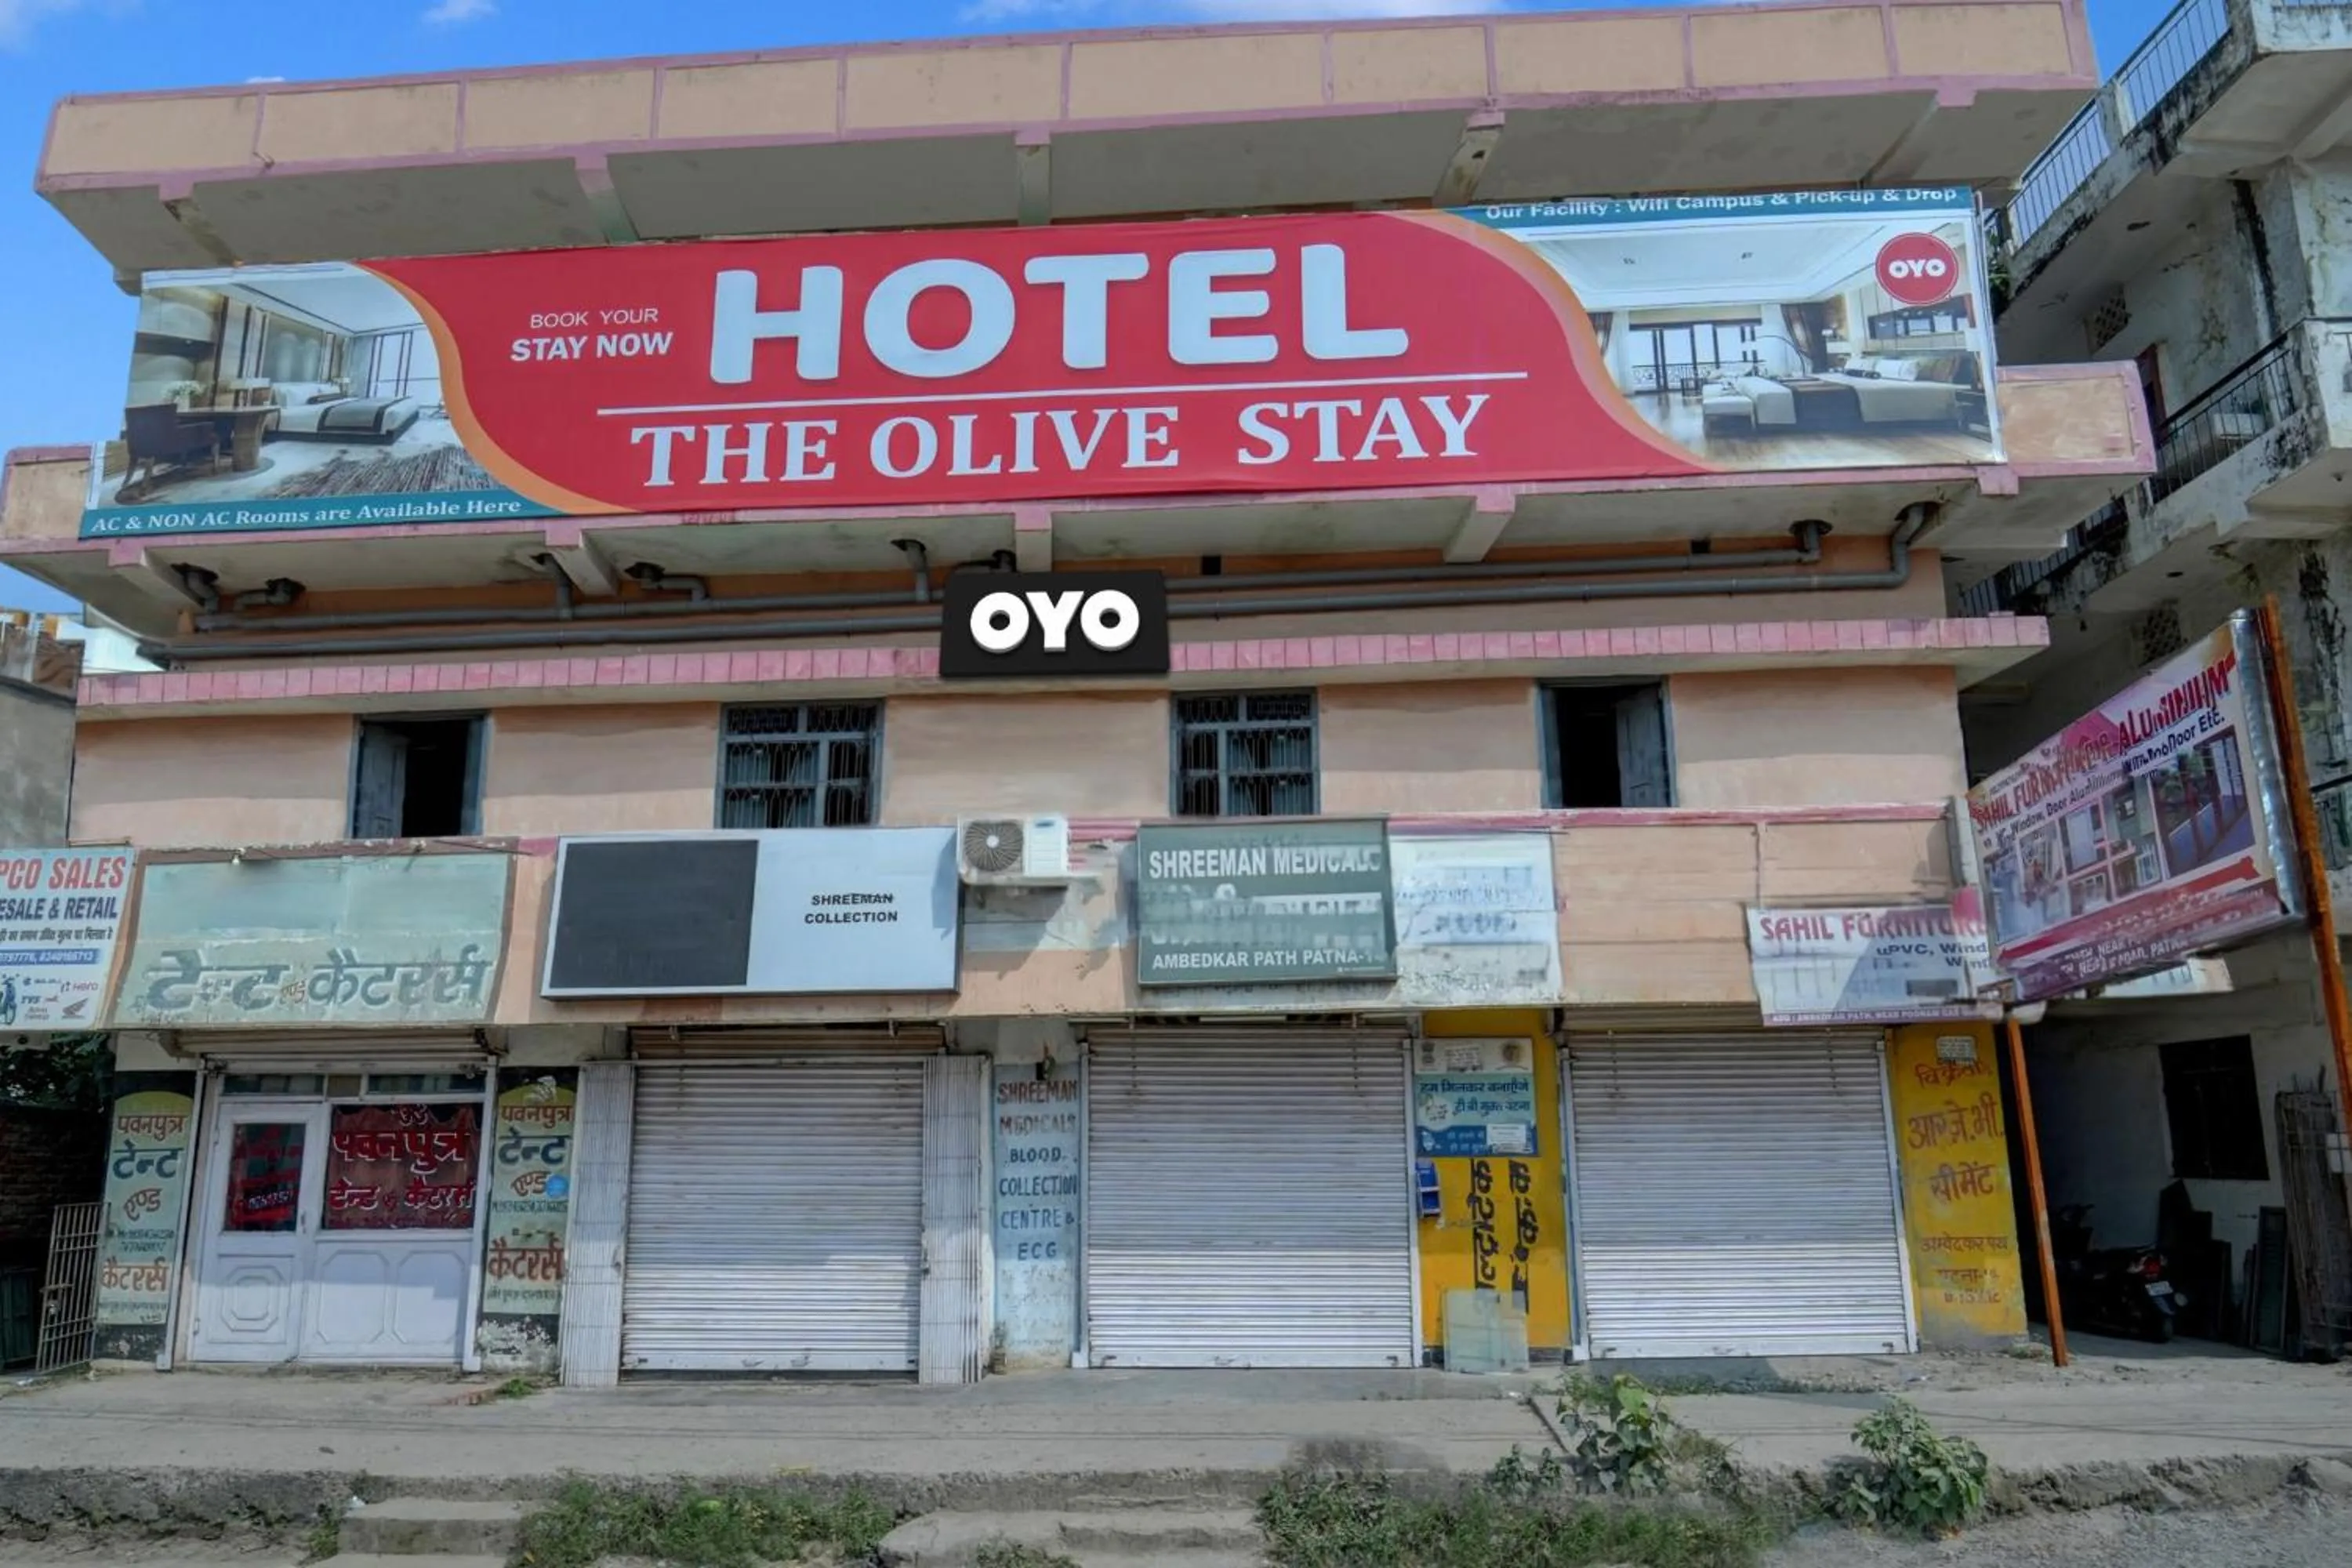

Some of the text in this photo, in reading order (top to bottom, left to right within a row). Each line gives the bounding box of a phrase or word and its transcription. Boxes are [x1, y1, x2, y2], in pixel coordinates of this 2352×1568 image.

[1486, 205, 1523, 220] Our
[1676, 196, 1764, 212] Campus
[1770, 192, 1789, 205] &
[1882, 189, 1900, 201] &
[1906, 187, 1957, 201] Drop
[1889, 259, 1946, 279] OYO
[530, 308, 659, 329] BOOK YOUR
[710, 243, 1409, 384] HOTEL
[510, 331, 674, 361] STAY NOW
[630, 394, 1491, 488] THE OLIVE STAY
[91, 499, 522, 532] AC & NON AC Rooms are Available Here
[970, 590, 1139, 653] OYO
[0, 856, 126, 890] CO SALES
[1149, 848, 1266, 879] SHREEMAN
[49, 897, 60, 920] &
[64, 895, 118, 920] RETAIL
[811, 893, 894, 906] SHREEMAN
[804, 911, 898, 924] COLLECTION
[1760, 916, 1835, 942] SAHIL
[1152, 953, 1248, 970] AMBEDKAR
[1254, 950, 1298, 966] PATH
[998, 1080, 1077, 1105] SHREEMAN
[1010, 1147, 1061, 1163] BLOOD
[999, 1173, 1077, 1197] COLLECTION
[1000, 1208, 1062, 1229] CENTRE
[1018, 1241, 1057, 1261] ECG
